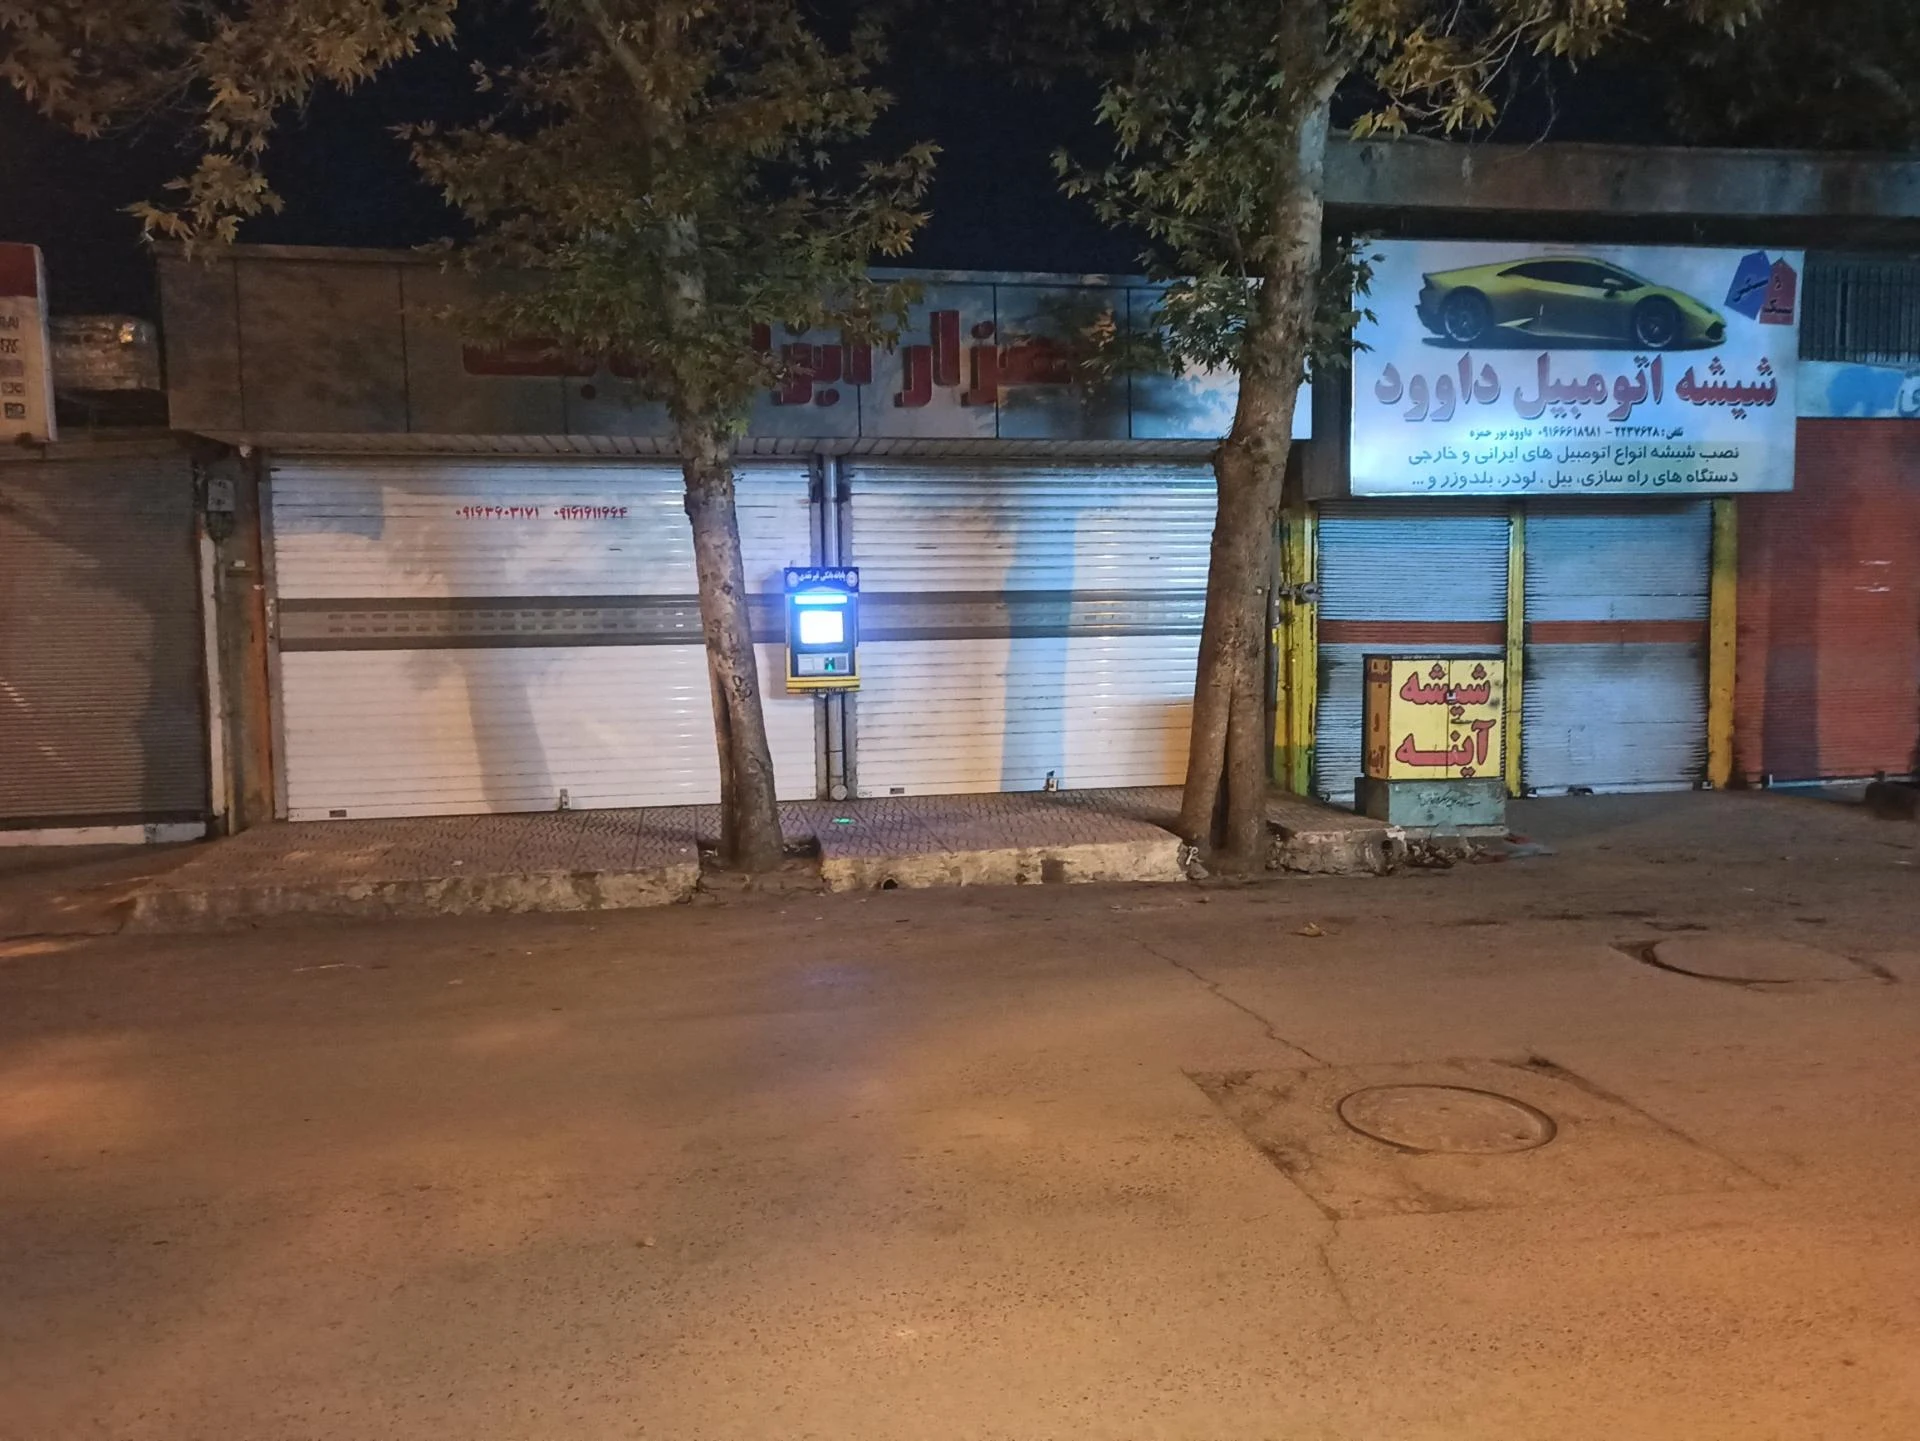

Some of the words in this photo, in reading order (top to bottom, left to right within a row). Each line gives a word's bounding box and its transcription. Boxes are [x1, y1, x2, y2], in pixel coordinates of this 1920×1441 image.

[1374, 351, 1501, 422] داوود
[1513, 353, 1664, 420] اتومبیل
[1675, 356, 1779, 420] شیشه
[1408, 446, 1458, 465] خارجی
[1461, 449, 1471, 464] و
[1475, 446, 1519, 465] ایرانی
[1523, 446, 1553, 463] های
[1557, 446, 1611, 466] اتومبیل
[1614, 445, 1647, 465] انواع
[1650, 445, 1696, 463] شیشه
[1699, 447, 1739, 463] نصب
[1427, 476, 1437, 490] و
[1440, 471, 1494, 490] بلدوزر
[1548, 470, 1573, 489] بیل
[1627, 469, 1649, 486] راه
[1653, 469, 1683, 486] های
[1686, 468, 1739, 483] دستگاه
[1399, 662, 1491, 717] شیشه
[1395, 718, 1496, 778] آینه
